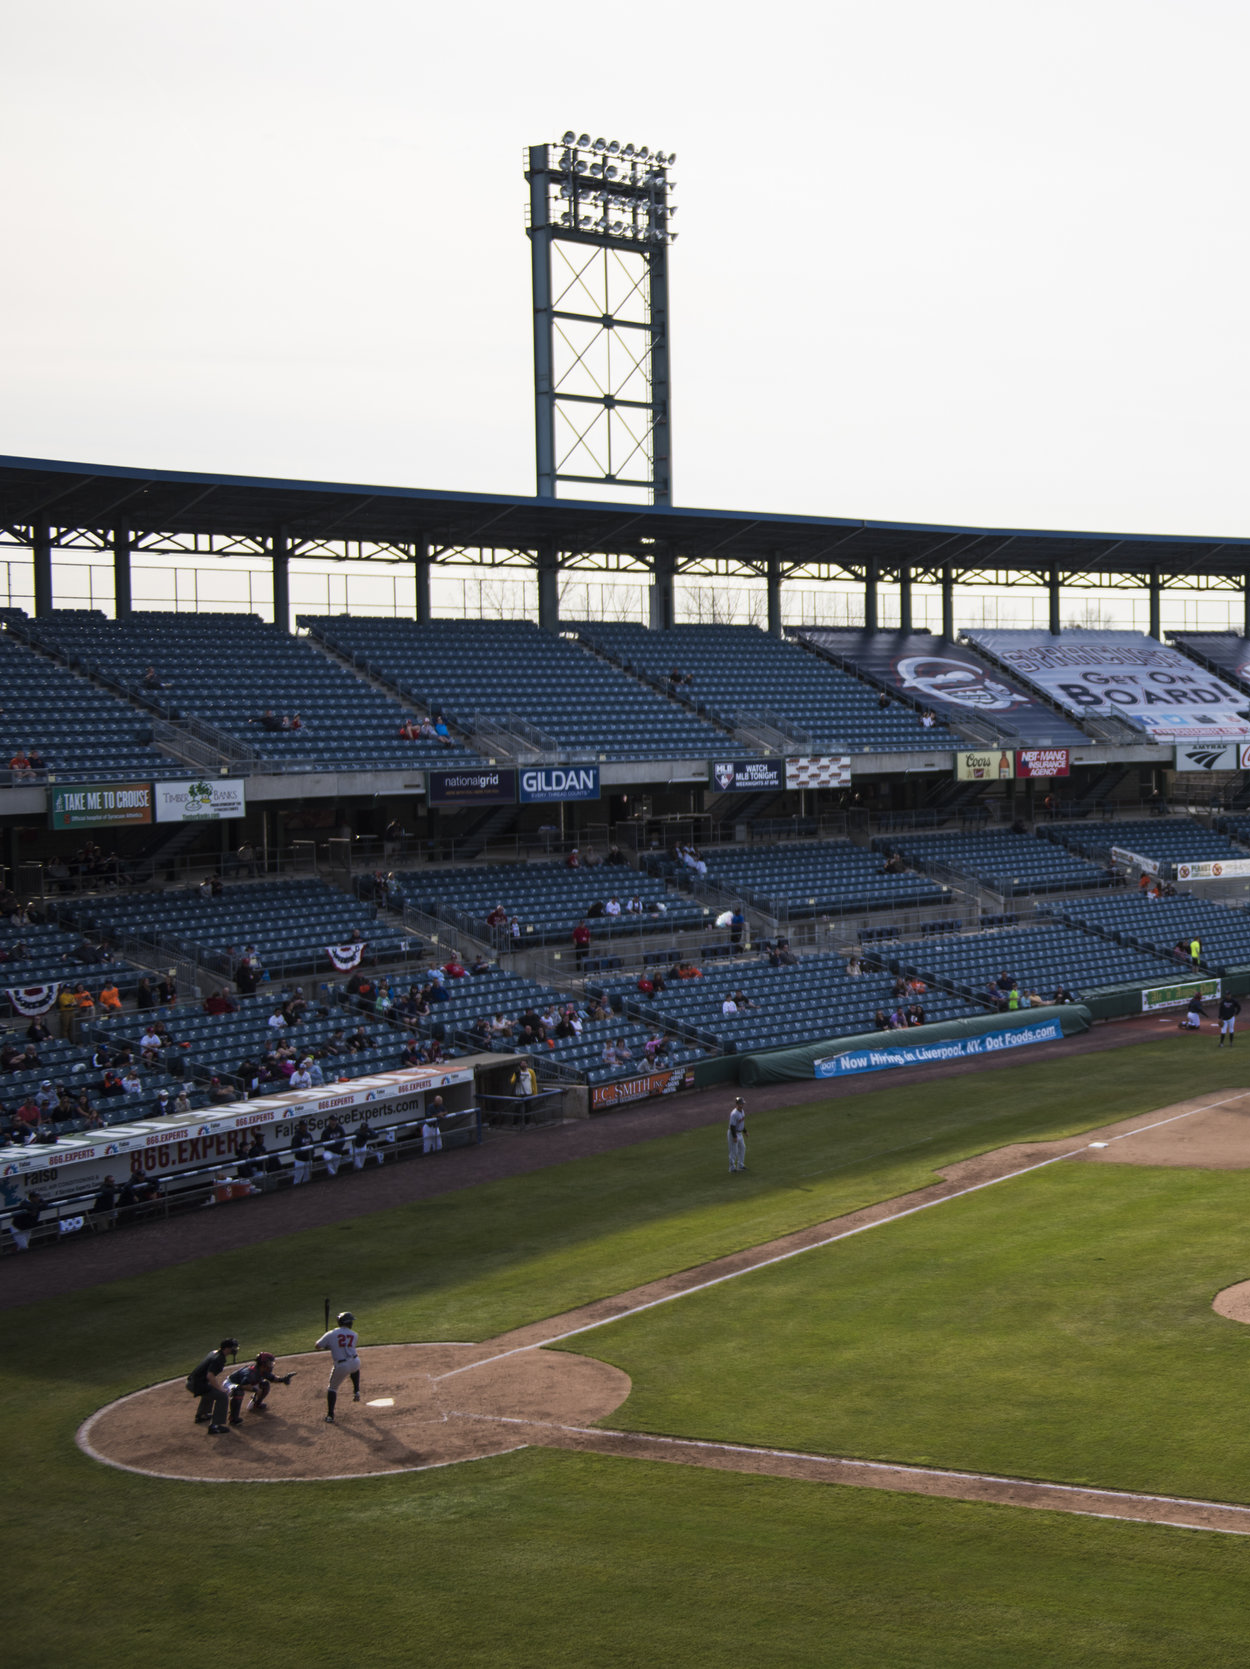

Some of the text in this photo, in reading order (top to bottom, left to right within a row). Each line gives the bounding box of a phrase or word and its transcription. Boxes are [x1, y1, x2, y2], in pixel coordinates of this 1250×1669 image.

[1002, 645, 1194, 673] SYRACUSE
[1058, 682, 1240, 706] BOARD!
[966, 753, 991, 767] Coors
[1028, 760, 1067, 769] INSURANCE
[716, 763, 733, 773] MLB
[745, 764, 768, 773] WATCH
[1030, 768, 1058, 776] AGENCY
[445, 773, 499, 788] nationalgrid
[523, 770, 594, 792] GILDAN
[736, 771, 778, 781] MLB TONIGHT
[64, 789, 150, 812] TAKE ME TO CROUSE
[841, 1056, 867, 1070] Now
[870, 1050, 904, 1066] Hiring
[906, 1050, 914, 1062] in
[986, 1036, 1003, 1050] Dot
[1005, 1025, 1056, 1045] Foods.com
[398, 1079, 432, 1093] 866.EXPERTS
[614, 1078, 651, 1098] SMITH
[318, 1095, 354, 1110] 866.EXPERTS
[235, 1111, 275, 1127] 866.EXPERTS
[146, 1129, 189, 1146] 866.EXPERTS
[49, 1148, 95, 1165] 866.EXPERTS
[337, 1333, 354, 1348] 27
